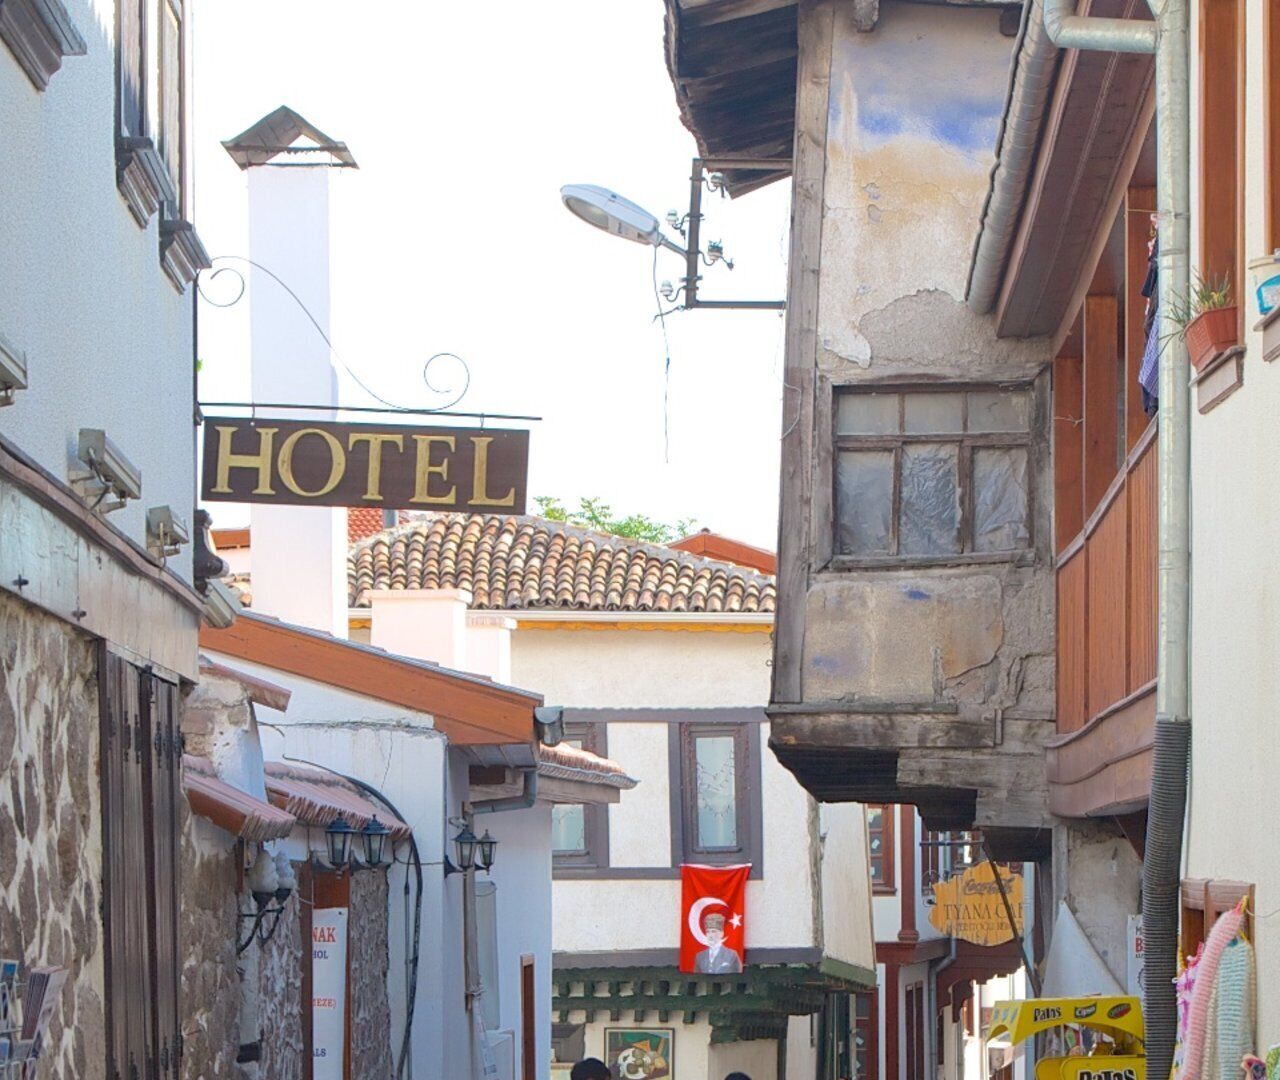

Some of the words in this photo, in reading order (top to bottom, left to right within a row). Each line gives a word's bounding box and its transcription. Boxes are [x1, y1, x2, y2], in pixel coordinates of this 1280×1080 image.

[210, 426, 516, 507] HOTEL
[943, 903, 992, 921] TYANA
[312, 926, 336, 943] NAK
[312, 949, 329, 960] HOL
[312, 1048, 327, 1057] LS
